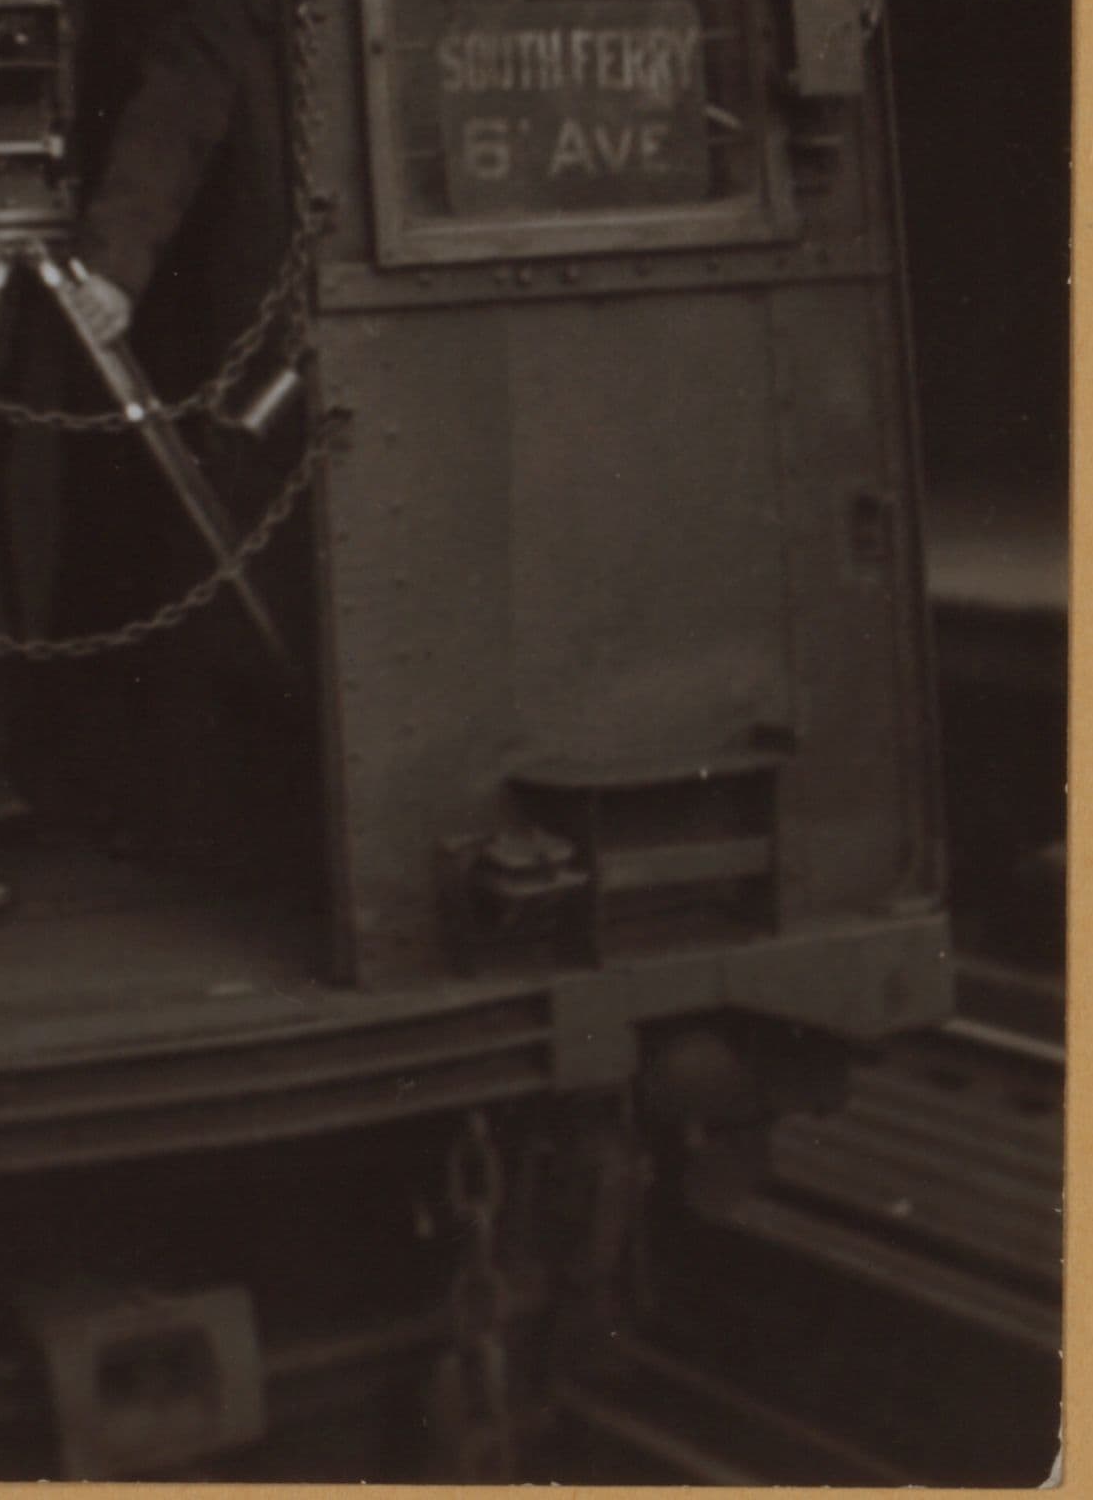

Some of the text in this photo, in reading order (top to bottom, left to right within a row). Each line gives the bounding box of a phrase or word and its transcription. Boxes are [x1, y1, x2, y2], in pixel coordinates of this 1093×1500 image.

[438, 27, 698, 92] SOUTH FERRY
[548, 117, 671, 179] AVE
